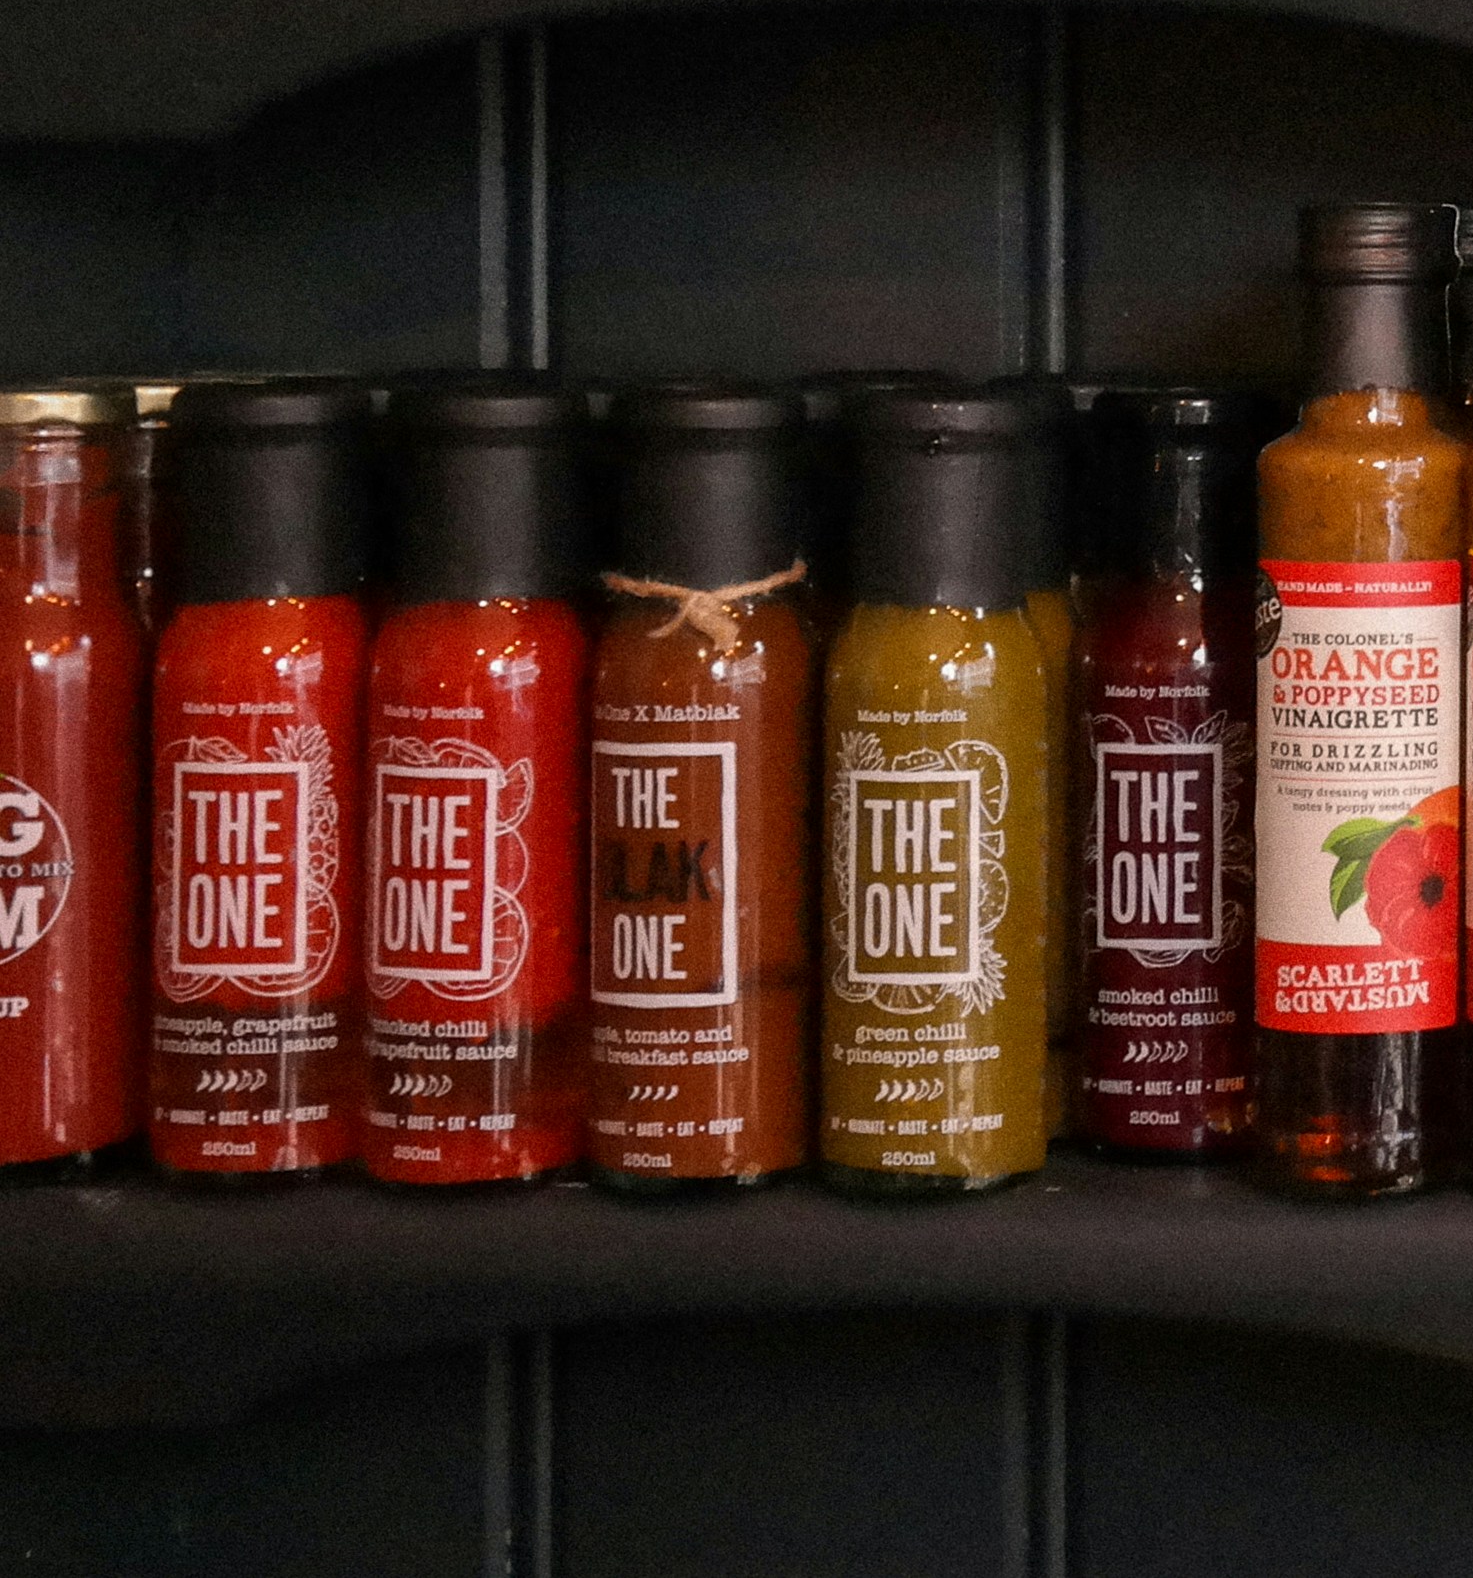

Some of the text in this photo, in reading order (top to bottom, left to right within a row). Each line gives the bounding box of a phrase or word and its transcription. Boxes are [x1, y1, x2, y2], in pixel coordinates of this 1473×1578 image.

[1292, 632, 1413, 646] THE COLONEL'S
[1271, 647, 1439, 682] ORANGE
[1105, 684, 1210, 701] Made by Norfolk
[1273, 685, 1440, 706] & POPPYSEED
[1272, 707, 1438, 730] VINAIGRETTE
[612, 768, 680, 829] THE
[1111, 770, 1200, 844] THE
[187, 790, 284, 865] THE
[385, 795, 472, 870] THE
[863, 798, 957, 874] THE
[31, 861, 75, 877] MIX
[1111, 851, 1201, 925] ONE
[186, 874, 283, 949] ONE
[384, 877, 470, 954] ONE
[863, 882, 957, 958] ONE
[613, 914, 688, 980] ONE
[1278, 958, 1423, 988] SCARLETT
[1098, 987, 1219, 1006] smoked chilli
[1101, 1009, 1181, 1027] beetroot
[1185, 1009, 1236, 1026] sauce
[855, 1023, 967, 1046] green chilli
[845, 1046, 939, 1068] pineapple
[943, 1045, 1000, 1063] sauce
[882, 1150, 936, 1166] 250ml
